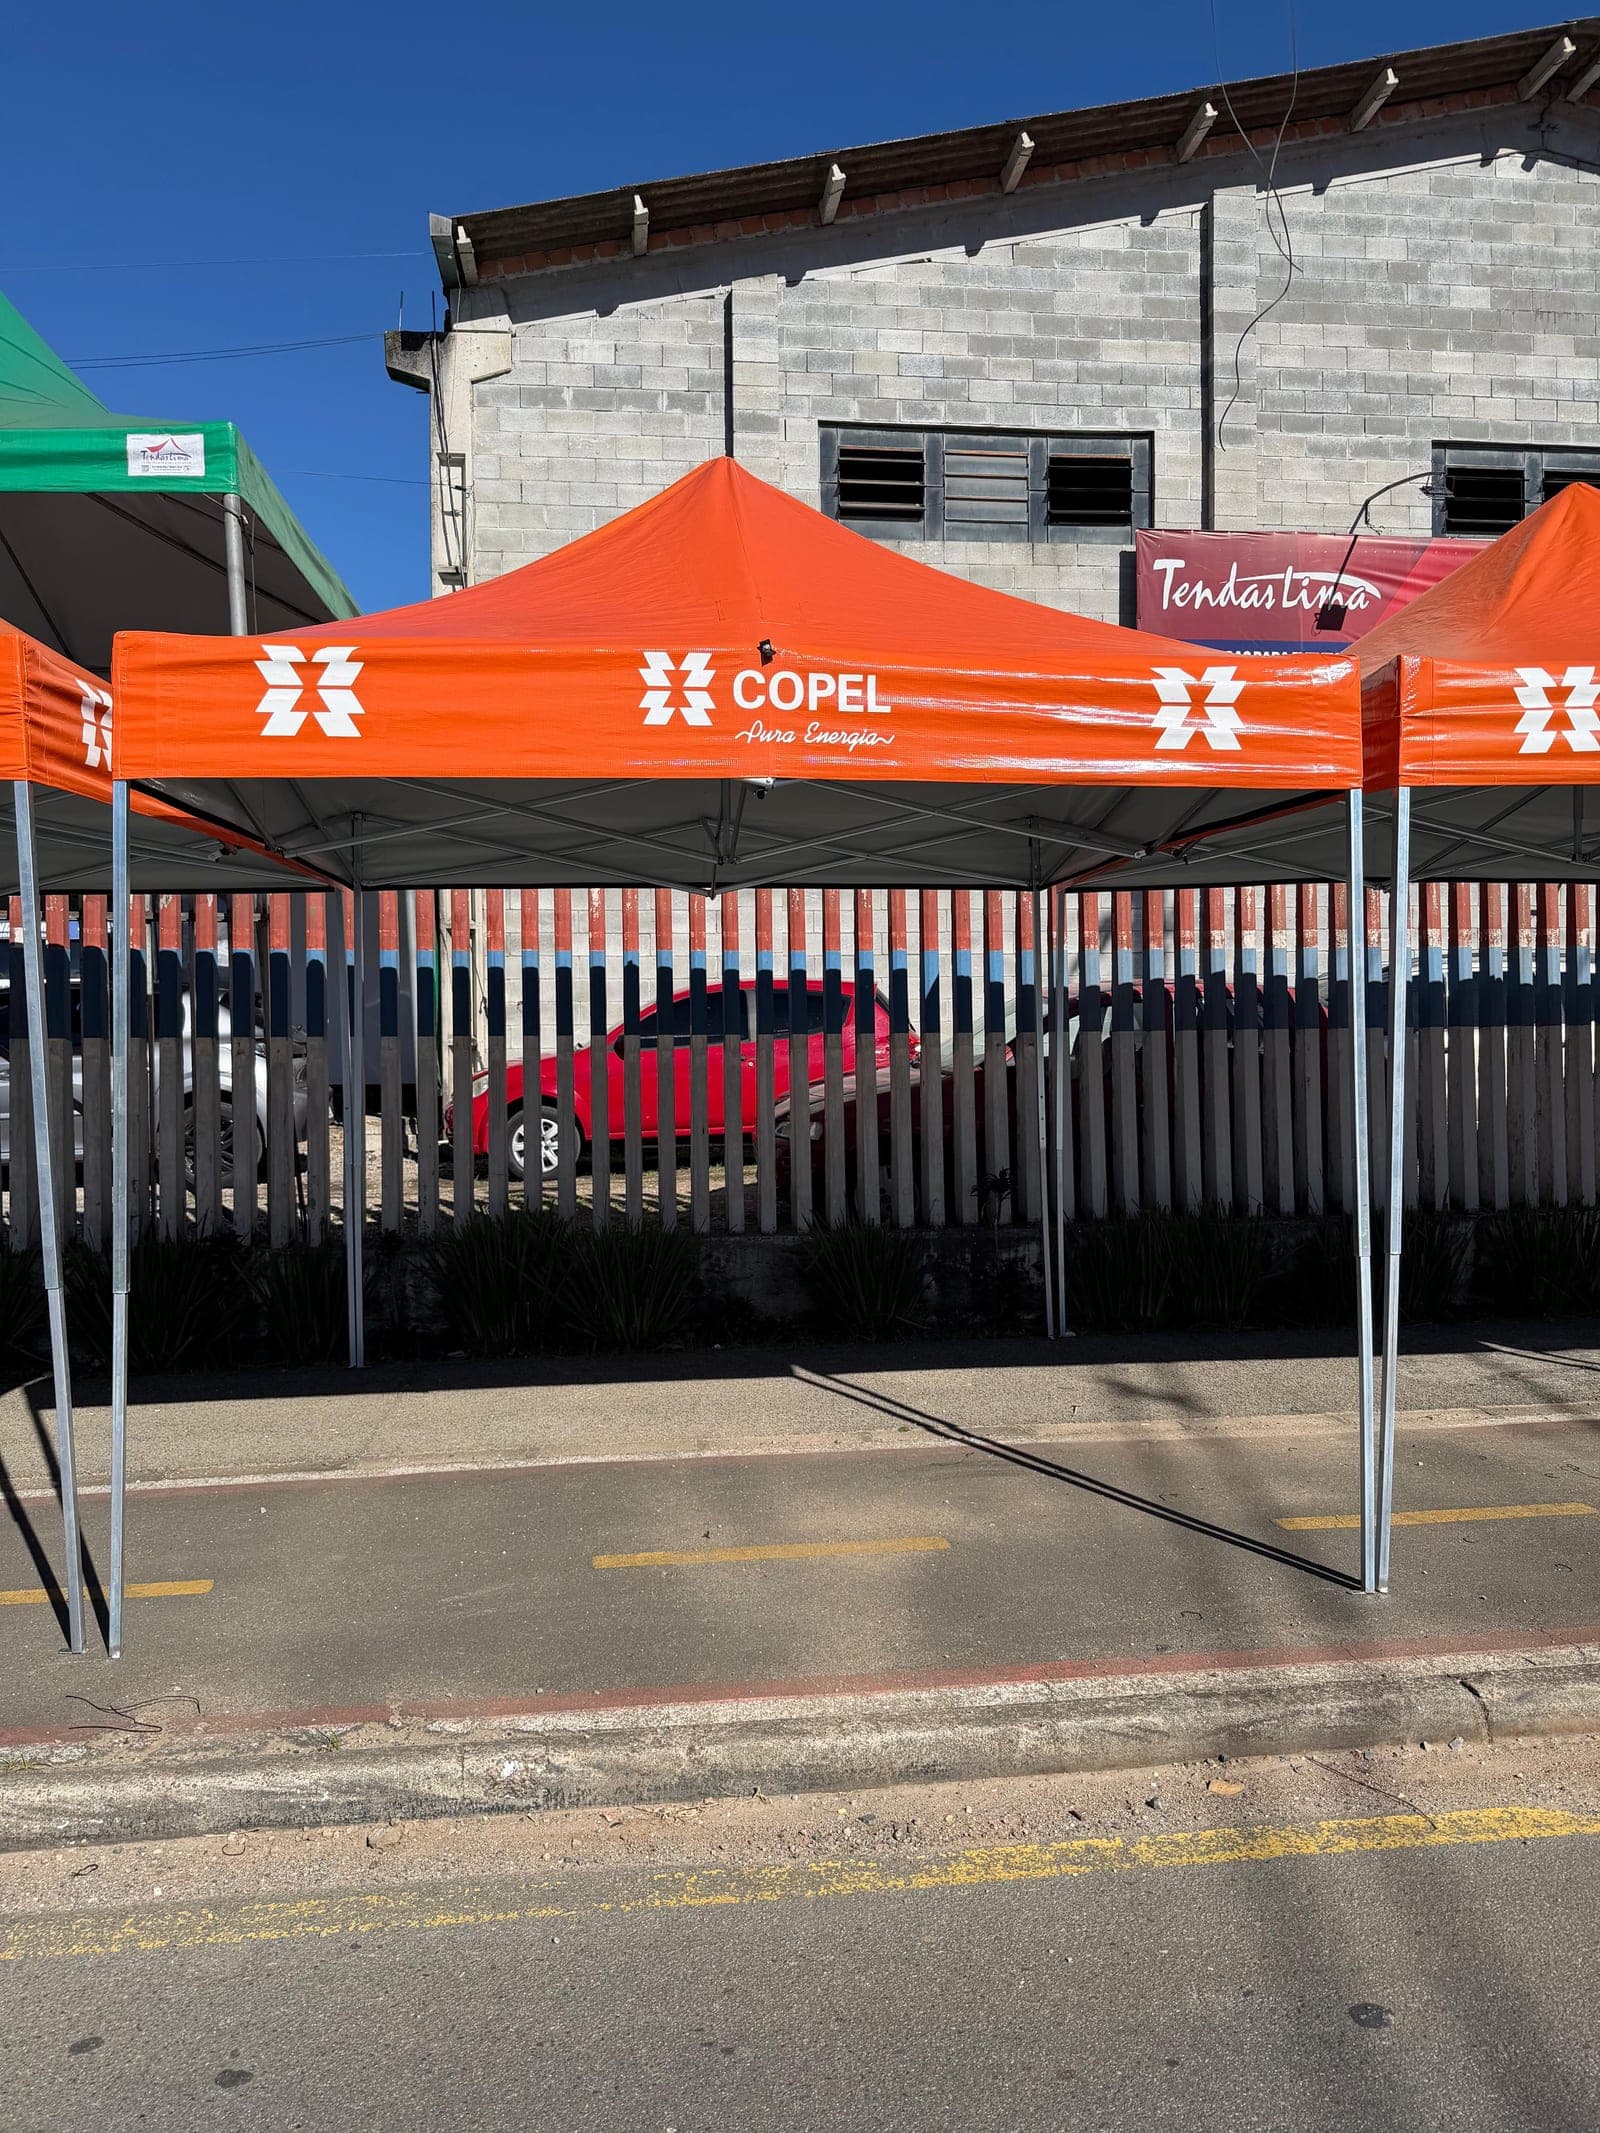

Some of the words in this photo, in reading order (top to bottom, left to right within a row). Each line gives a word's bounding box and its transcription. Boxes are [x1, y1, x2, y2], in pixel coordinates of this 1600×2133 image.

[732, 669, 892, 713] COPEL
[734, 719, 796, 744] Pura
[803, 721, 895, 752] Energia
